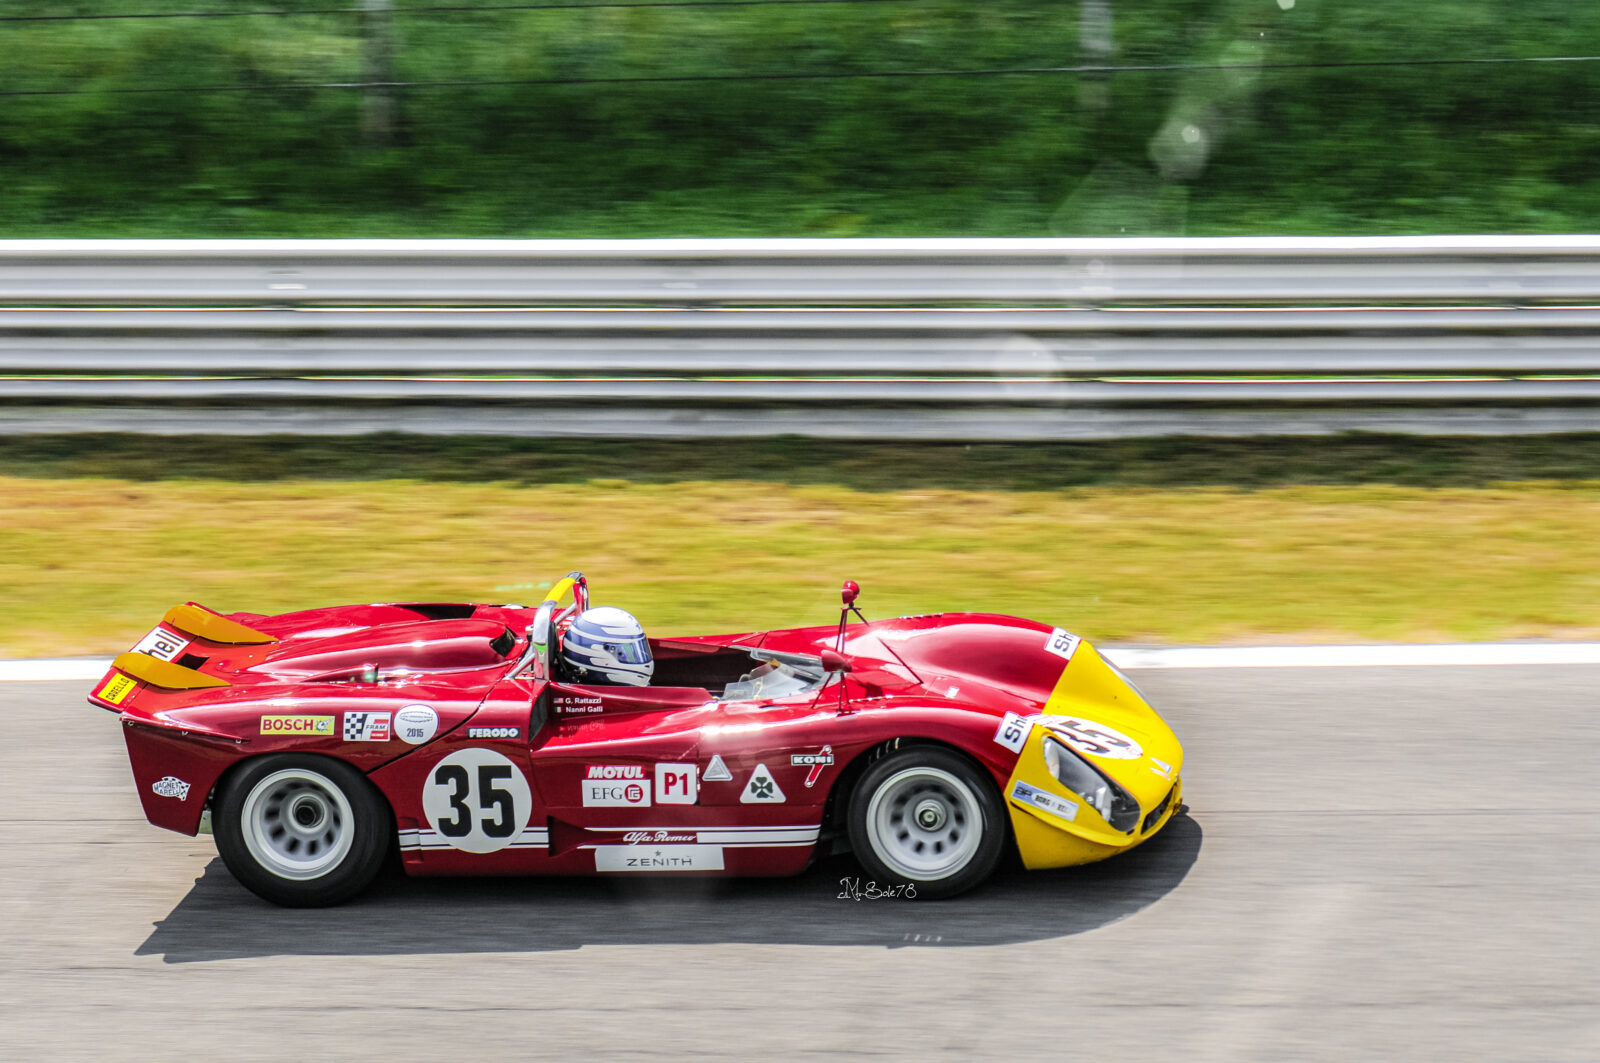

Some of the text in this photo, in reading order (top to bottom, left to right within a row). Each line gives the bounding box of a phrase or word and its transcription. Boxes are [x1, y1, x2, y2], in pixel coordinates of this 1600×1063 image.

[138, 629, 185, 659] hell
[262, 718, 314, 731] BOSCH
[406, 728, 424, 738] 2015
[468, 728, 519, 738] FERODO
[1046, 720, 1132, 755] 35
[792, 756, 831, 764] KONI
[587, 765, 644, 779] MOTUL
[664, 772, 689, 796] P1
[591, 787, 623, 800] EFG
[435, 764, 516, 838] 35
[623, 830, 697, 846] Alfa Romeo
[626, 858, 693, 867] ZENITH
